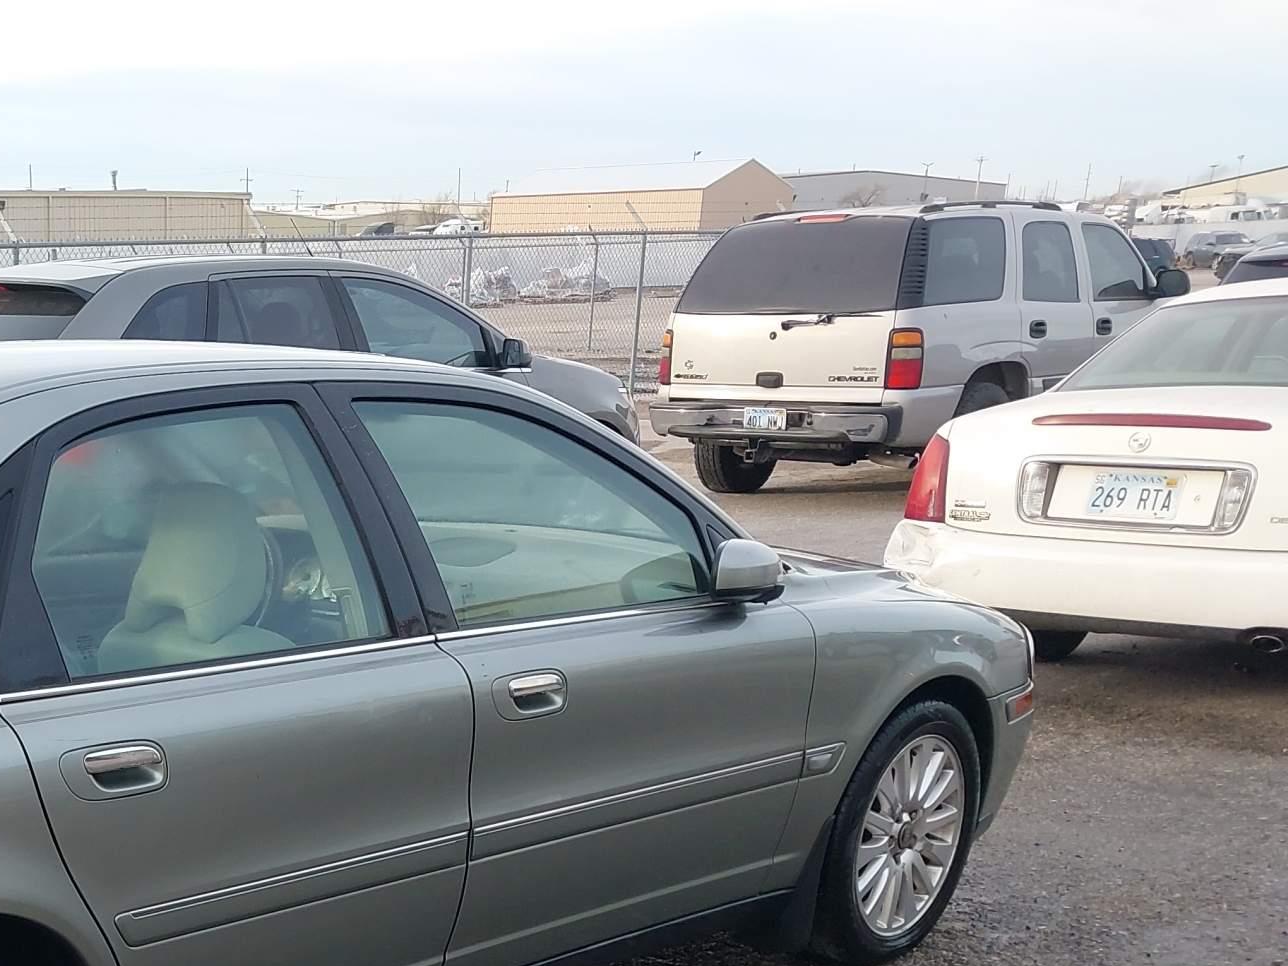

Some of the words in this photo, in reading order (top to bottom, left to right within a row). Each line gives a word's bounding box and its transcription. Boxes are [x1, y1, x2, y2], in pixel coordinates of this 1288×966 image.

[1113, 473, 1163, 485] KANSAS
[1091, 486, 1128, 508] 269
[1136, 488, 1173, 512] RTA
